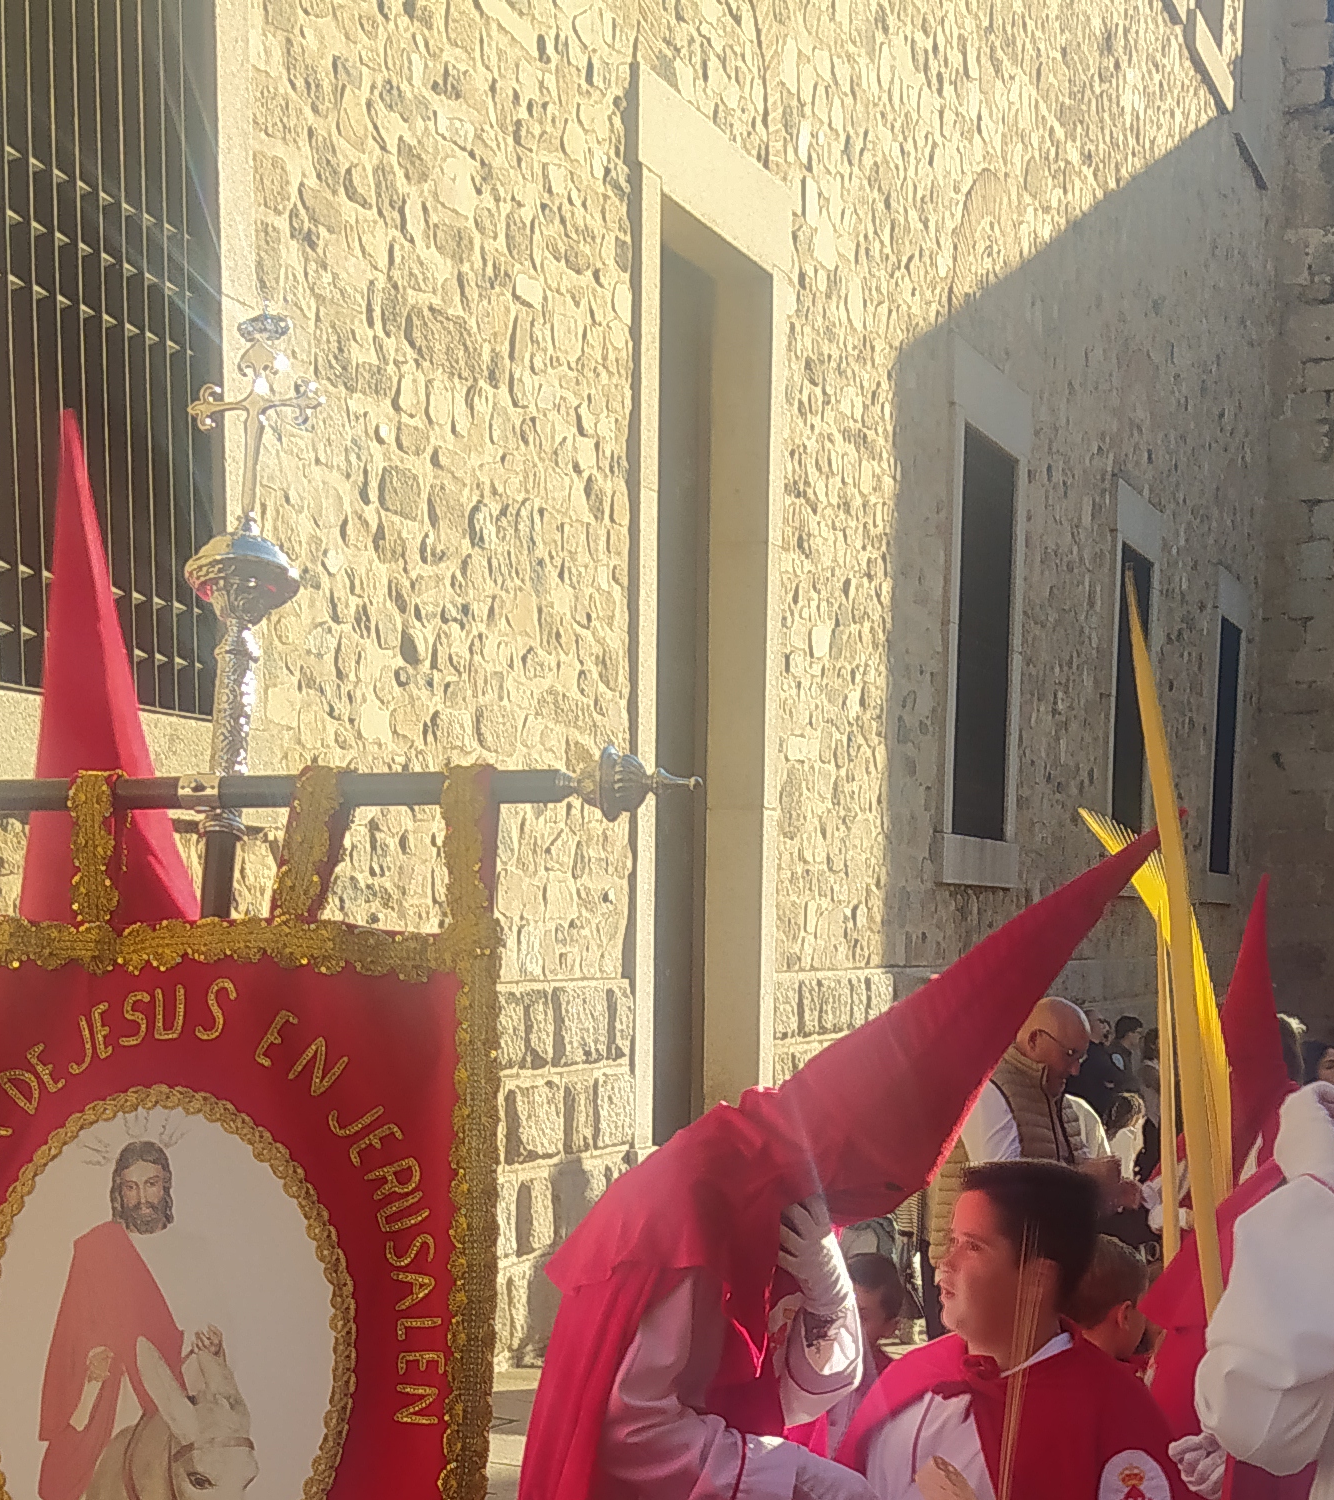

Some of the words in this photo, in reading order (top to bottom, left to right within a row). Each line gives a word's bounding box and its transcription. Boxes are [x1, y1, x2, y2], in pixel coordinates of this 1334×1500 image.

[68, 977, 239, 1076] JESUS
[254, 1008, 350, 1097] EN
[327, 1105, 446, 1426] JERUSALEN
